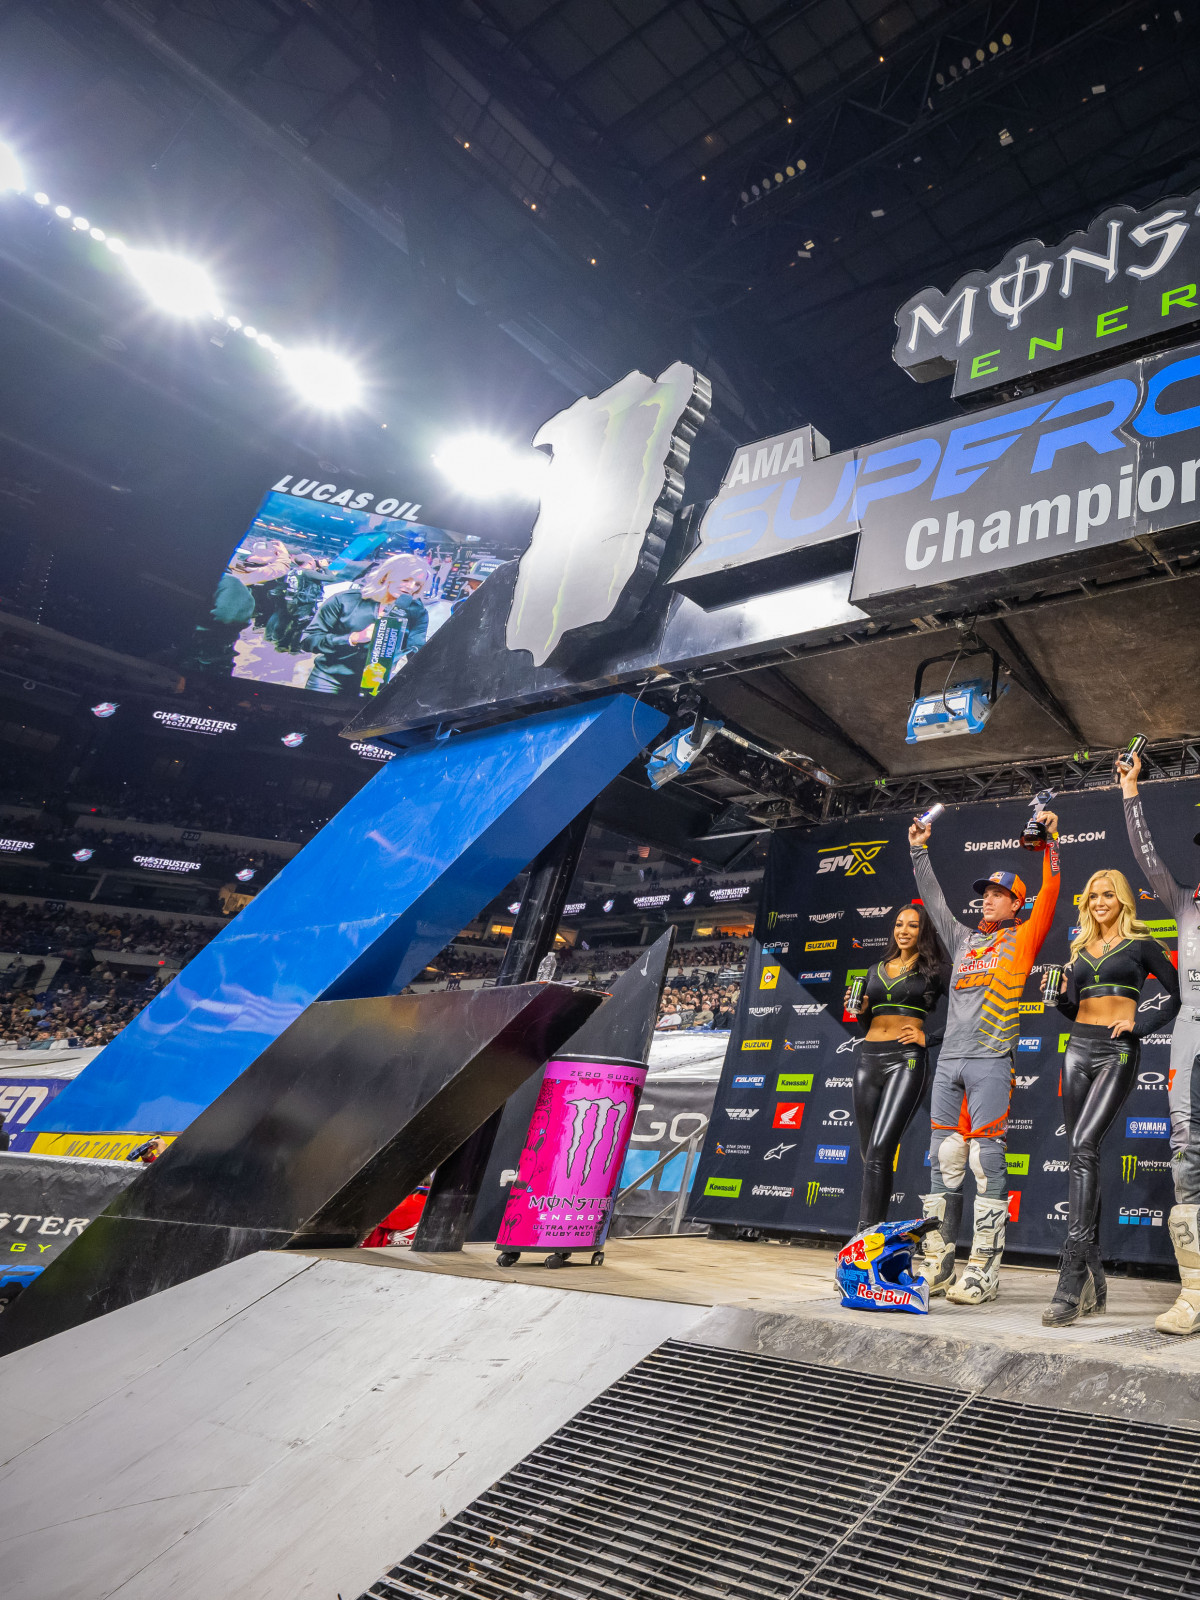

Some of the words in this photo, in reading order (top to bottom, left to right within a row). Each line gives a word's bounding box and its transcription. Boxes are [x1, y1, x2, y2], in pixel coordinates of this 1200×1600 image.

[728, 436, 805, 488] AMA
[271, 475, 374, 509] LUCAS
[375, 499, 422, 521] OIL
[371, 620, 388, 664] GHOSTBUSTERS
[153, 711, 237, 731] GHOSTBUSTERS
[162, 719, 192, 728] FROZEN
[195, 724, 223, 733] EMPIRE
[134, 856, 201, 870] GHOSTBUSTERS
[816, 847, 882, 876] SMX
[809, 912, 837, 922] TRIUMPH
[807, 942, 835, 950] SUZUKI
[977, 958, 998, 970] Bull
[800, 970, 831, 981] FALKEN
[955, 972, 994, 990] KTM
[749, 1006, 773, 1016] TRIUMPH
[1019, 1004, 1041, 1013] ZUKI
[744, 1041, 769, 1049] SUZUKI
[608, 1073, 639, 1082] SUGAR
[735, 1076, 764, 1084] FALKEN
[781, 1078, 809, 1087] Kawasaki
[1138, 1122, 1167, 1131] YAMAHA
[63, 1140, 139, 1161] MOTORC
[825, 1149, 846, 1158] YAMAHA
[1005, 1160, 1024, 1169] asaki
[1138, 1160, 1171, 1169] MONSTER
[709, 1183, 737, 1192] Kawasaki
[820, 1186, 844, 1194] MONSTER
[529, 1194, 613, 1212] MONSTER
[540, 1213, 603, 1221] ENERGY
[1120, 1207, 1163, 1217] GoPro
[0, 1213, 90, 1236] STER
[857, 1283, 884, 1300] Red
[884, 1289, 911, 1304] Bull
